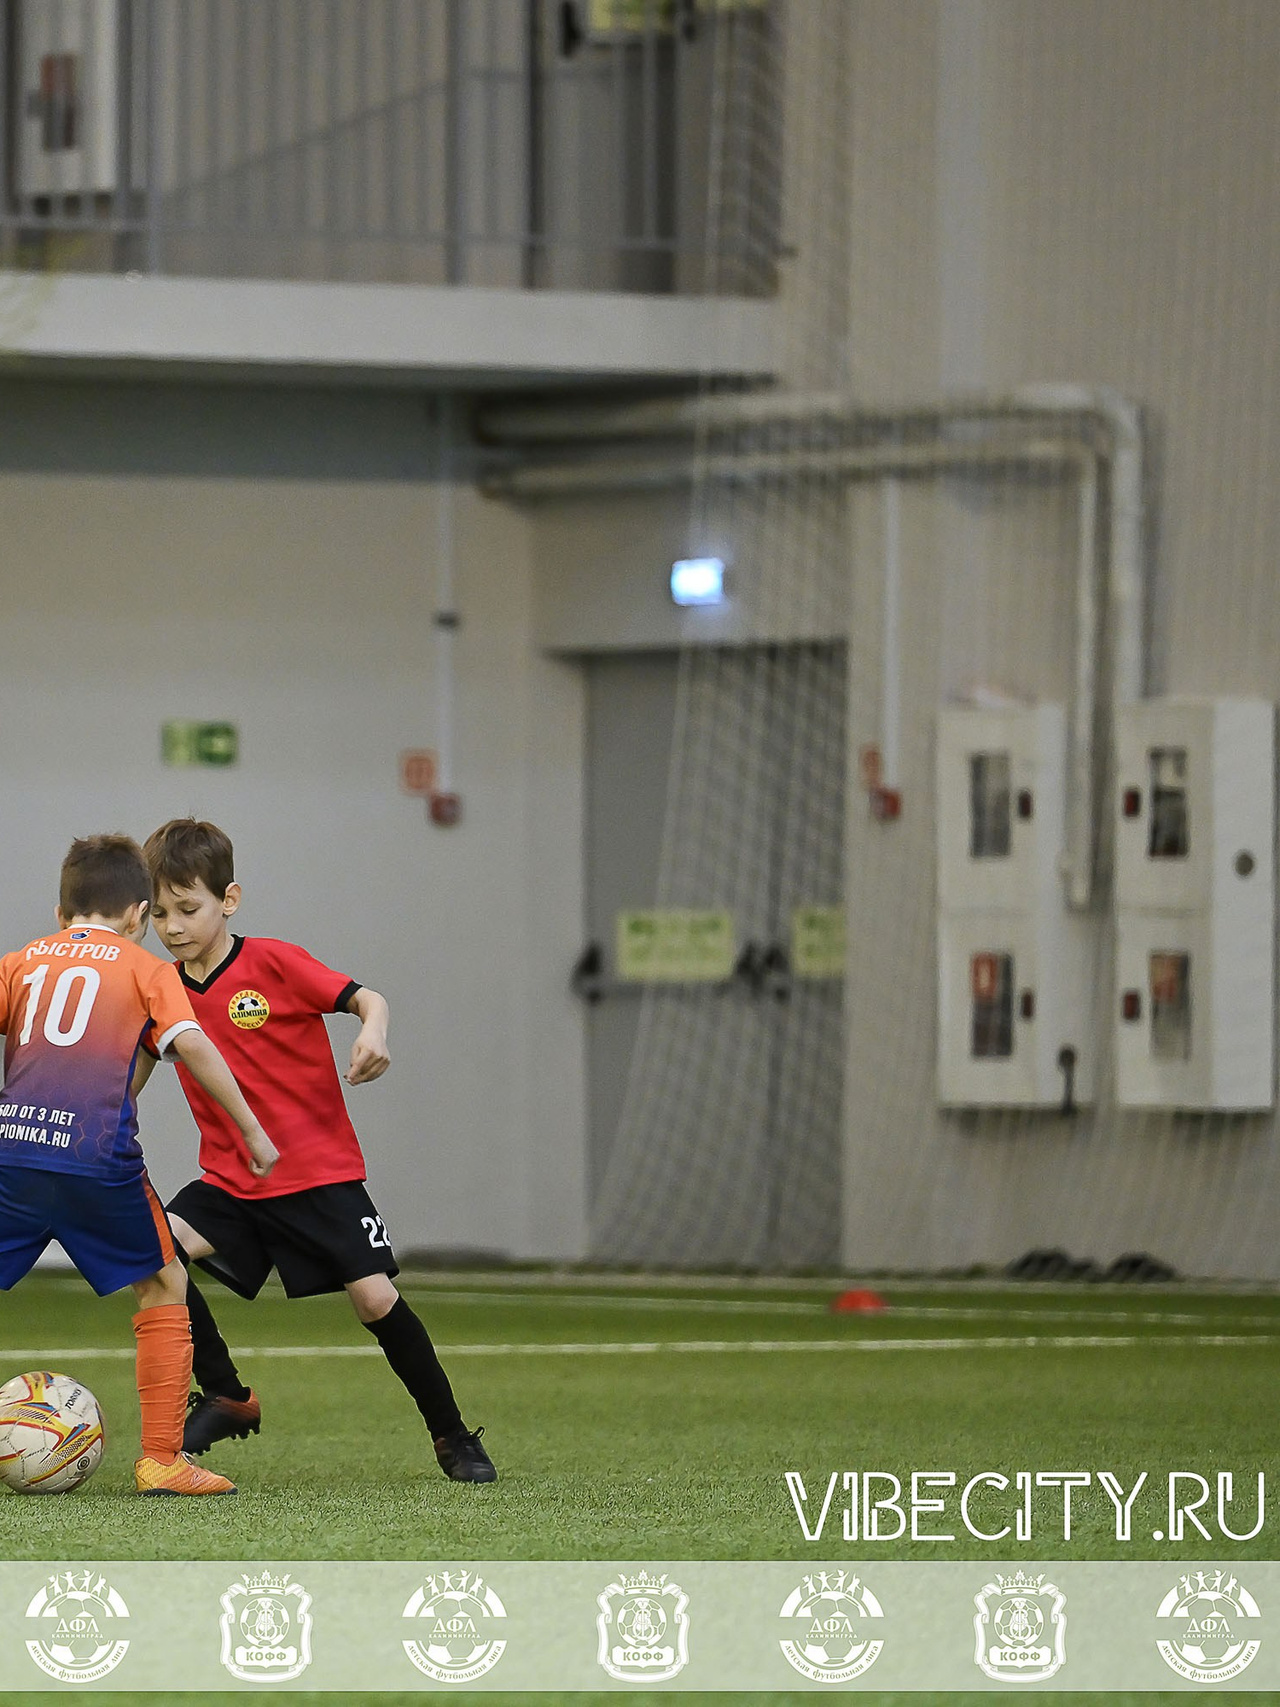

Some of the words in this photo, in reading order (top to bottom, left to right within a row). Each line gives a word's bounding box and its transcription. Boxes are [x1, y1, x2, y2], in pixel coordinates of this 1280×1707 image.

[19, 964, 101, 1047] 10
[19, 1105, 37, 1120] ОТ
[37, 1107, 48, 1122] 3
[48, 1109, 76, 1127] ЛЕТ
